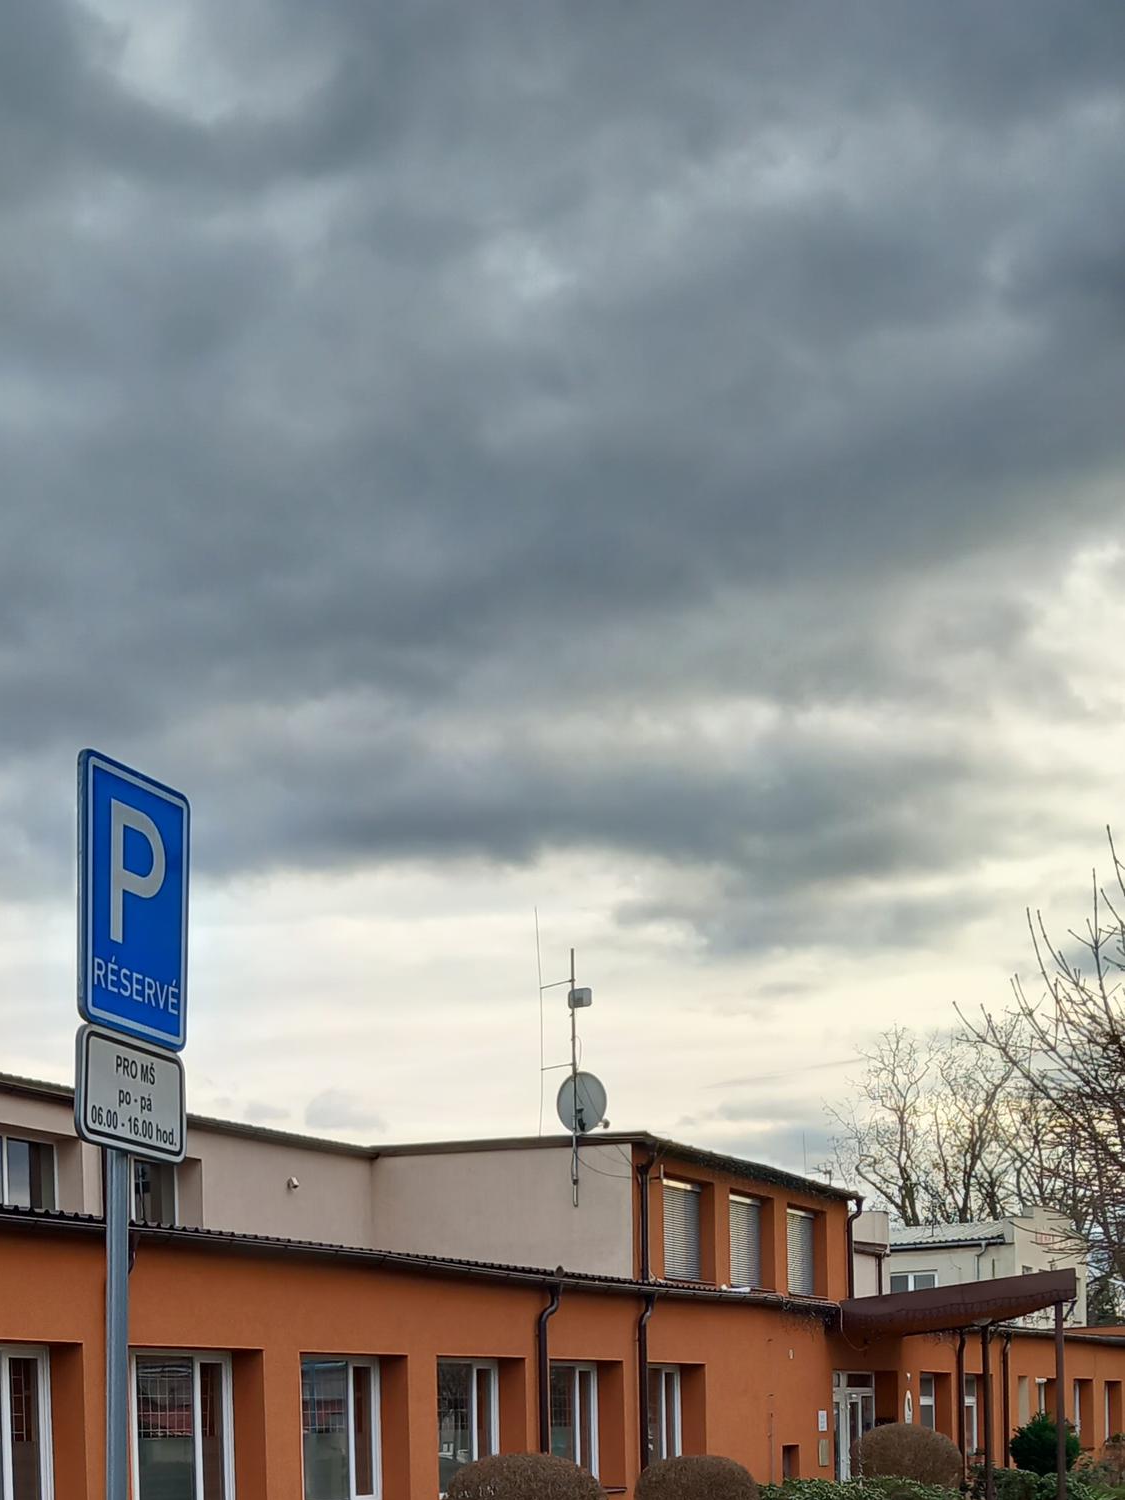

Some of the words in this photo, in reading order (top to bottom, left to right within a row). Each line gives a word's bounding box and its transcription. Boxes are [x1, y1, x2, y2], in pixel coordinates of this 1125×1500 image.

[109, 797, 166, 944] P
[93, 955, 179, 1016] RÉSERVÉ
[115, 1054, 138, 1079] PRO
[140, 1062, 156, 1086] MŠ
[118, 1089, 132, 1107] po
[140, 1093, 153, 1114] pá
[91, 1105, 118, 1130] 06.00
[127, 1115, 153, 1140] 16.00
[155, 1123, 177, 1147] hod.
